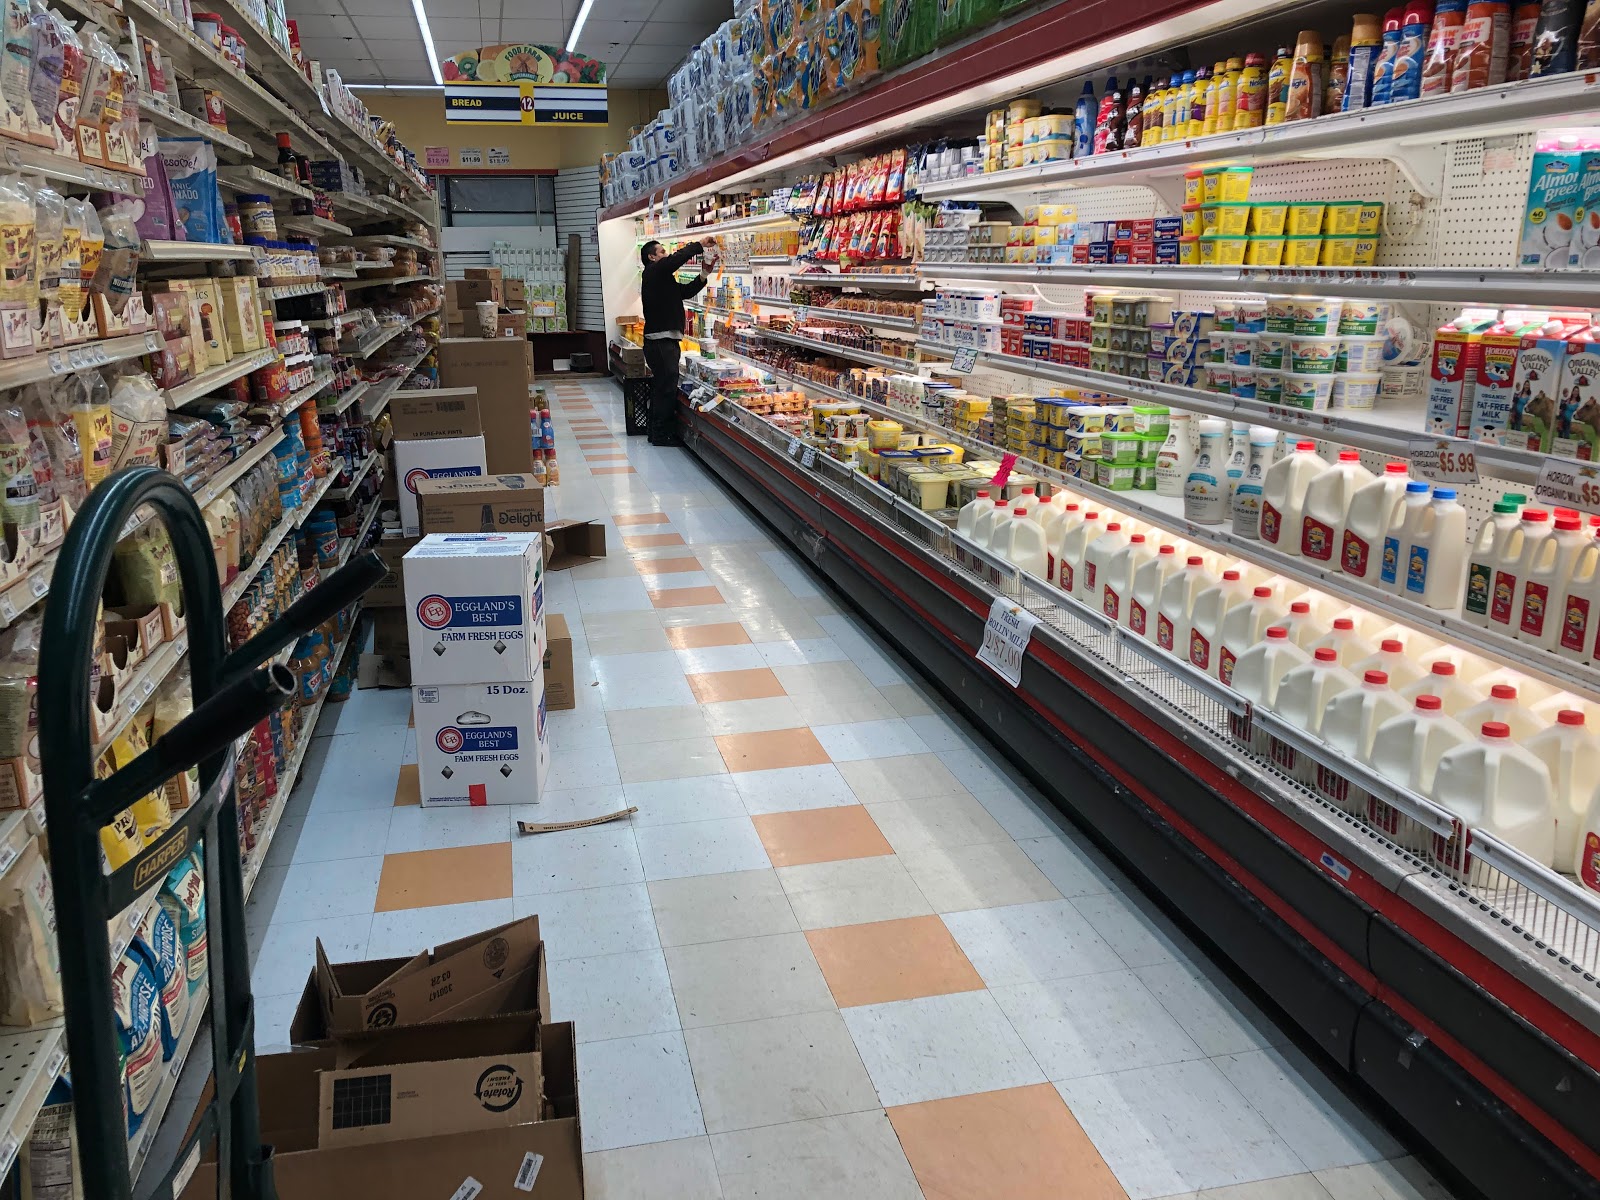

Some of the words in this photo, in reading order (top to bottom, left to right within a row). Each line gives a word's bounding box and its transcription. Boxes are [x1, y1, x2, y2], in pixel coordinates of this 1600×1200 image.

[504, 46, 521, 61] FOOD
[523, 46, 543, 62] FARM
[452, 99, 482, 107] BREAD
[521, 97, 533, 110] 12
[552, 112, 584, 120] JUICE
[1532, 210, 1544, 218] 40
[1484, 347, 1518, 357] HORIZON
[1520, 354, 1552, 367] ORGANIC
[1522, 362, 1548, 373] VALLEY
[1570, 367, 1599, 379] VALLEY
[1477, 401, 1510, 412] FAT-FREE
[1482, 410, 1501, 419] MILK
[1410, 450, 1439, 458] HORIZON
[1440, 450, 1475, 476] $5.99
[1546, 471, 1576, 486] HORIZON
[498, 511, 543, 527] Delight
[472, 613, 499, 623] BEST
[1001, 610, 1020, 630] FRESH
[441, 632, 466, 642] FARM
[467, 631, 497, 641] FRESH
[498, 630, 524, 640] EGGS
[1008, 631, 1026, 650] MILK
[487, 685, 500, 695] 15
[503, 685, 529, 694] Doz.
[465, 730, 513, 740] EGGLAND'S
[478, 740, 500, 748] BEST
[454, 755, 474, 763] FARM
[475, 754, 498, 762] FRESH
[499, 753, 519, 761] EGGS
[139, 834, 185, 882] HARPER
[429, 984, 453, 1002] 300147
